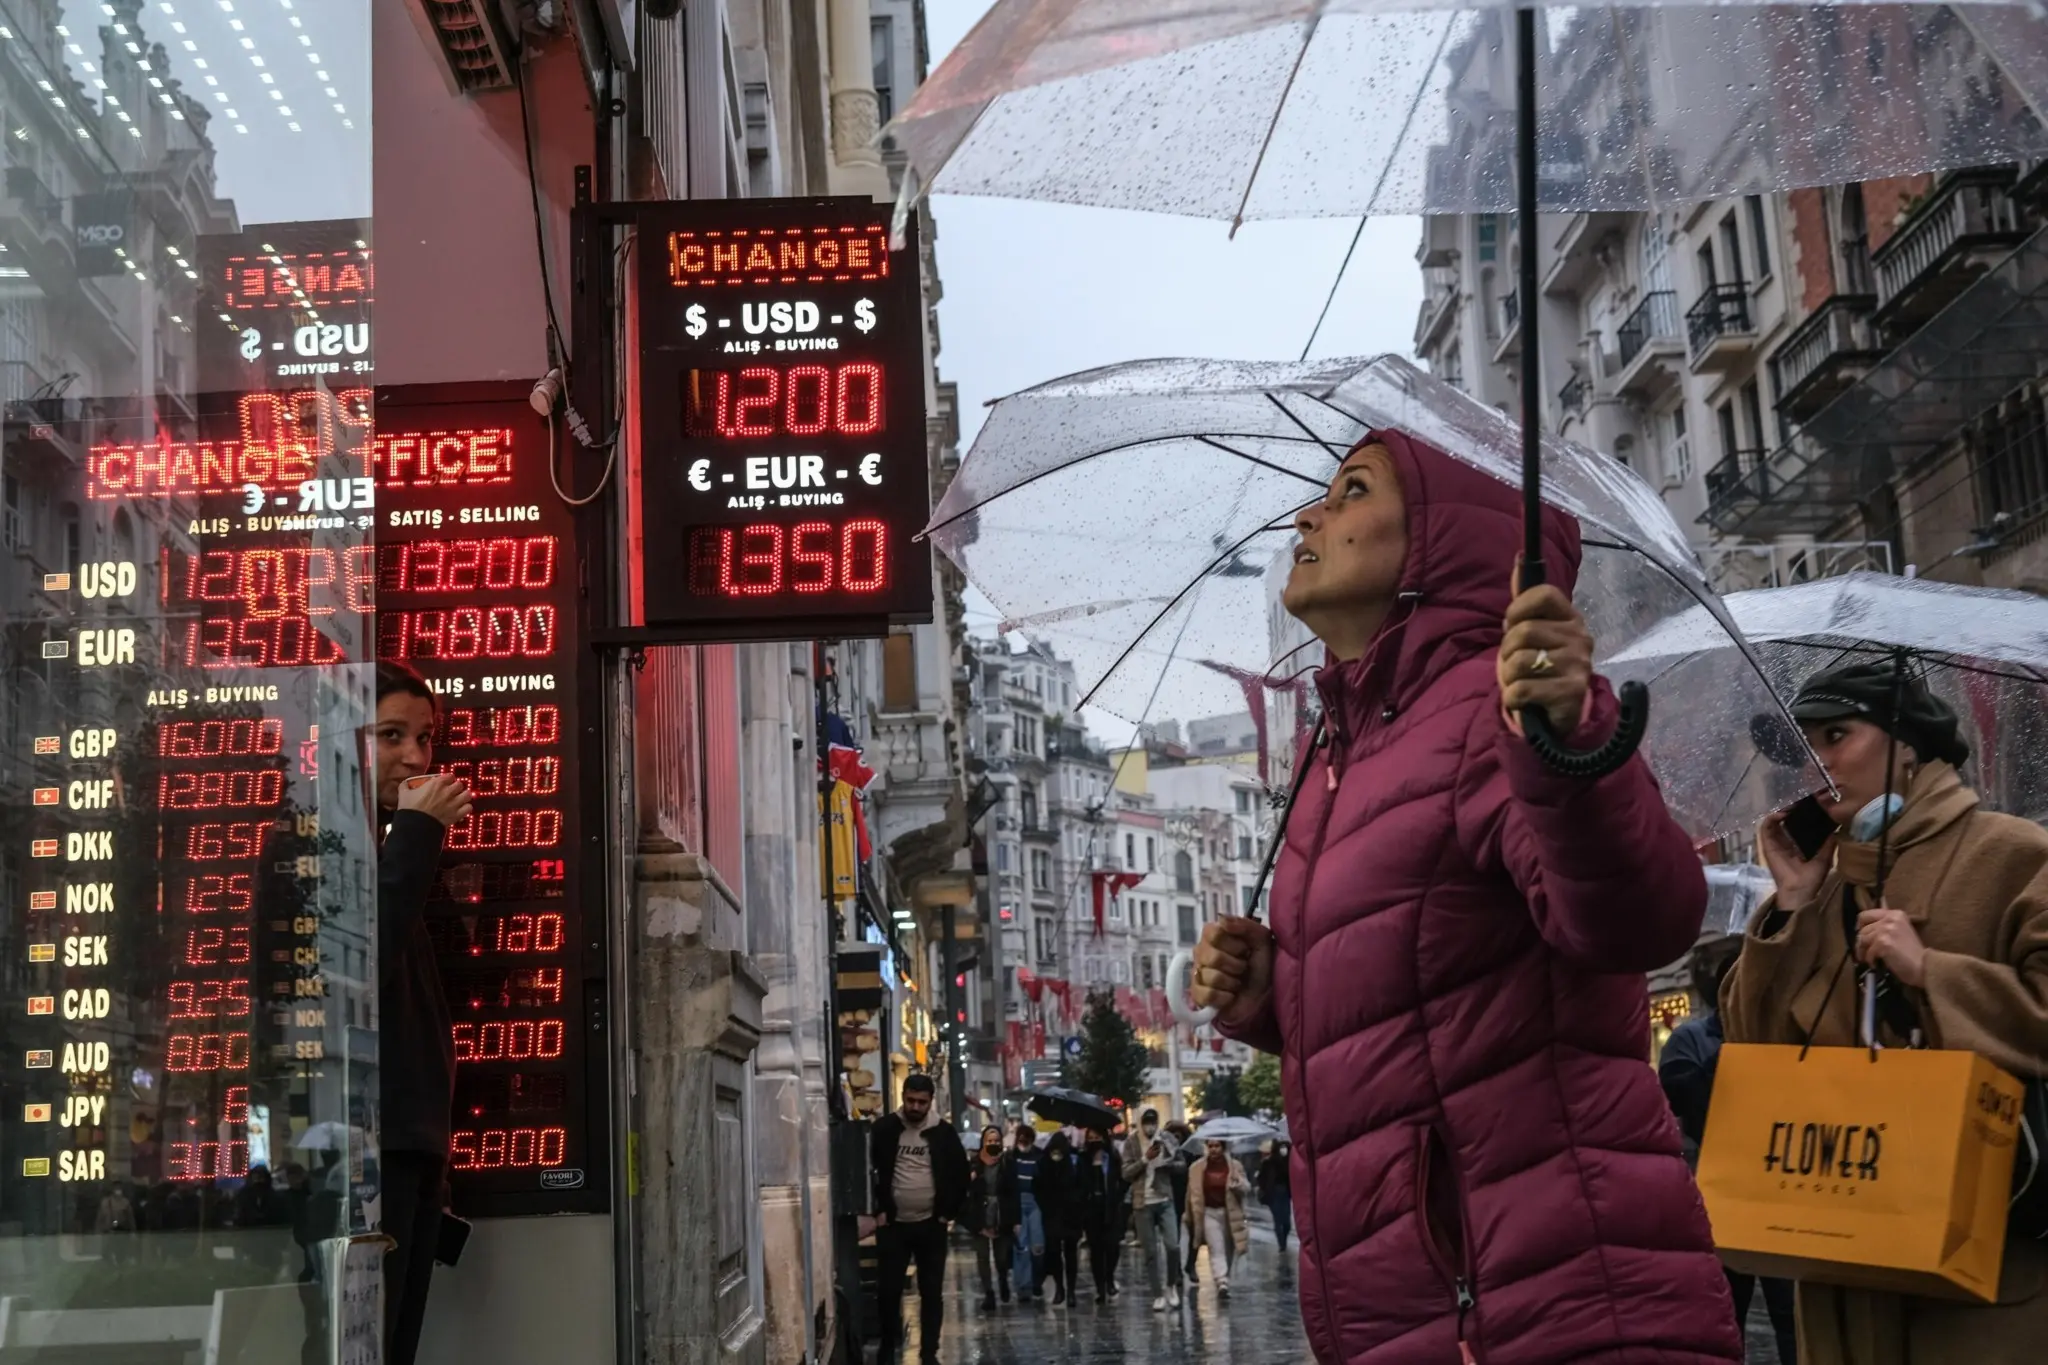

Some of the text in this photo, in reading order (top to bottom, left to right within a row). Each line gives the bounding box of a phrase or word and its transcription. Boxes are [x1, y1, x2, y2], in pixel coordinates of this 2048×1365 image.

[679, 238, 871, 273] CHANGE
[685, 303, 707, 340] $
[742, 300, 820, 334] USD
[854, 298, 876, 334] $
[724, 339, 760, 355] ALIŞ
[775, 338, 839, 352] BUYING
[99, 445, 306, 488] CHANGE
[687, 458, 712, 492] €
[746, 455, 826, 489] EUR
[859, 453, 883, 486] €
[390, 509, 443, 529] SATIŞ
[460, 506, 540, 523] SELLING
[728, 495, 764, 511] ALIŞ
[780, 493, 844, 507] BUYING
[189, 519, 230, 537] ALIŞ
[80, 561, 136, 599] USD
[78, 629, 135, 666] EUR
[147, 688, 188, 708] ALIŞ
[207, 685, 278, 702] BUYING
[482, 674, 555, 692] BUYING
[70, 728, 117, 758] GBP
[68, 779, 114, 810] CHF
[296, 815, 318, 837] US
[67, 831, 113, 861] DKK
[296, 857, 318, 877] EU
[66, 883, 114, 914] NOK
[64, 935, 108, 967] SEK
[63, 988, 110, 1020] CAD
[61, 1042, 109, 1073] AUD
[60, 1095, 105, 1128] JPY
[59, 1150, 105, 1181] SAR
[1764, 1121, 1882, 1181] FLOWER
